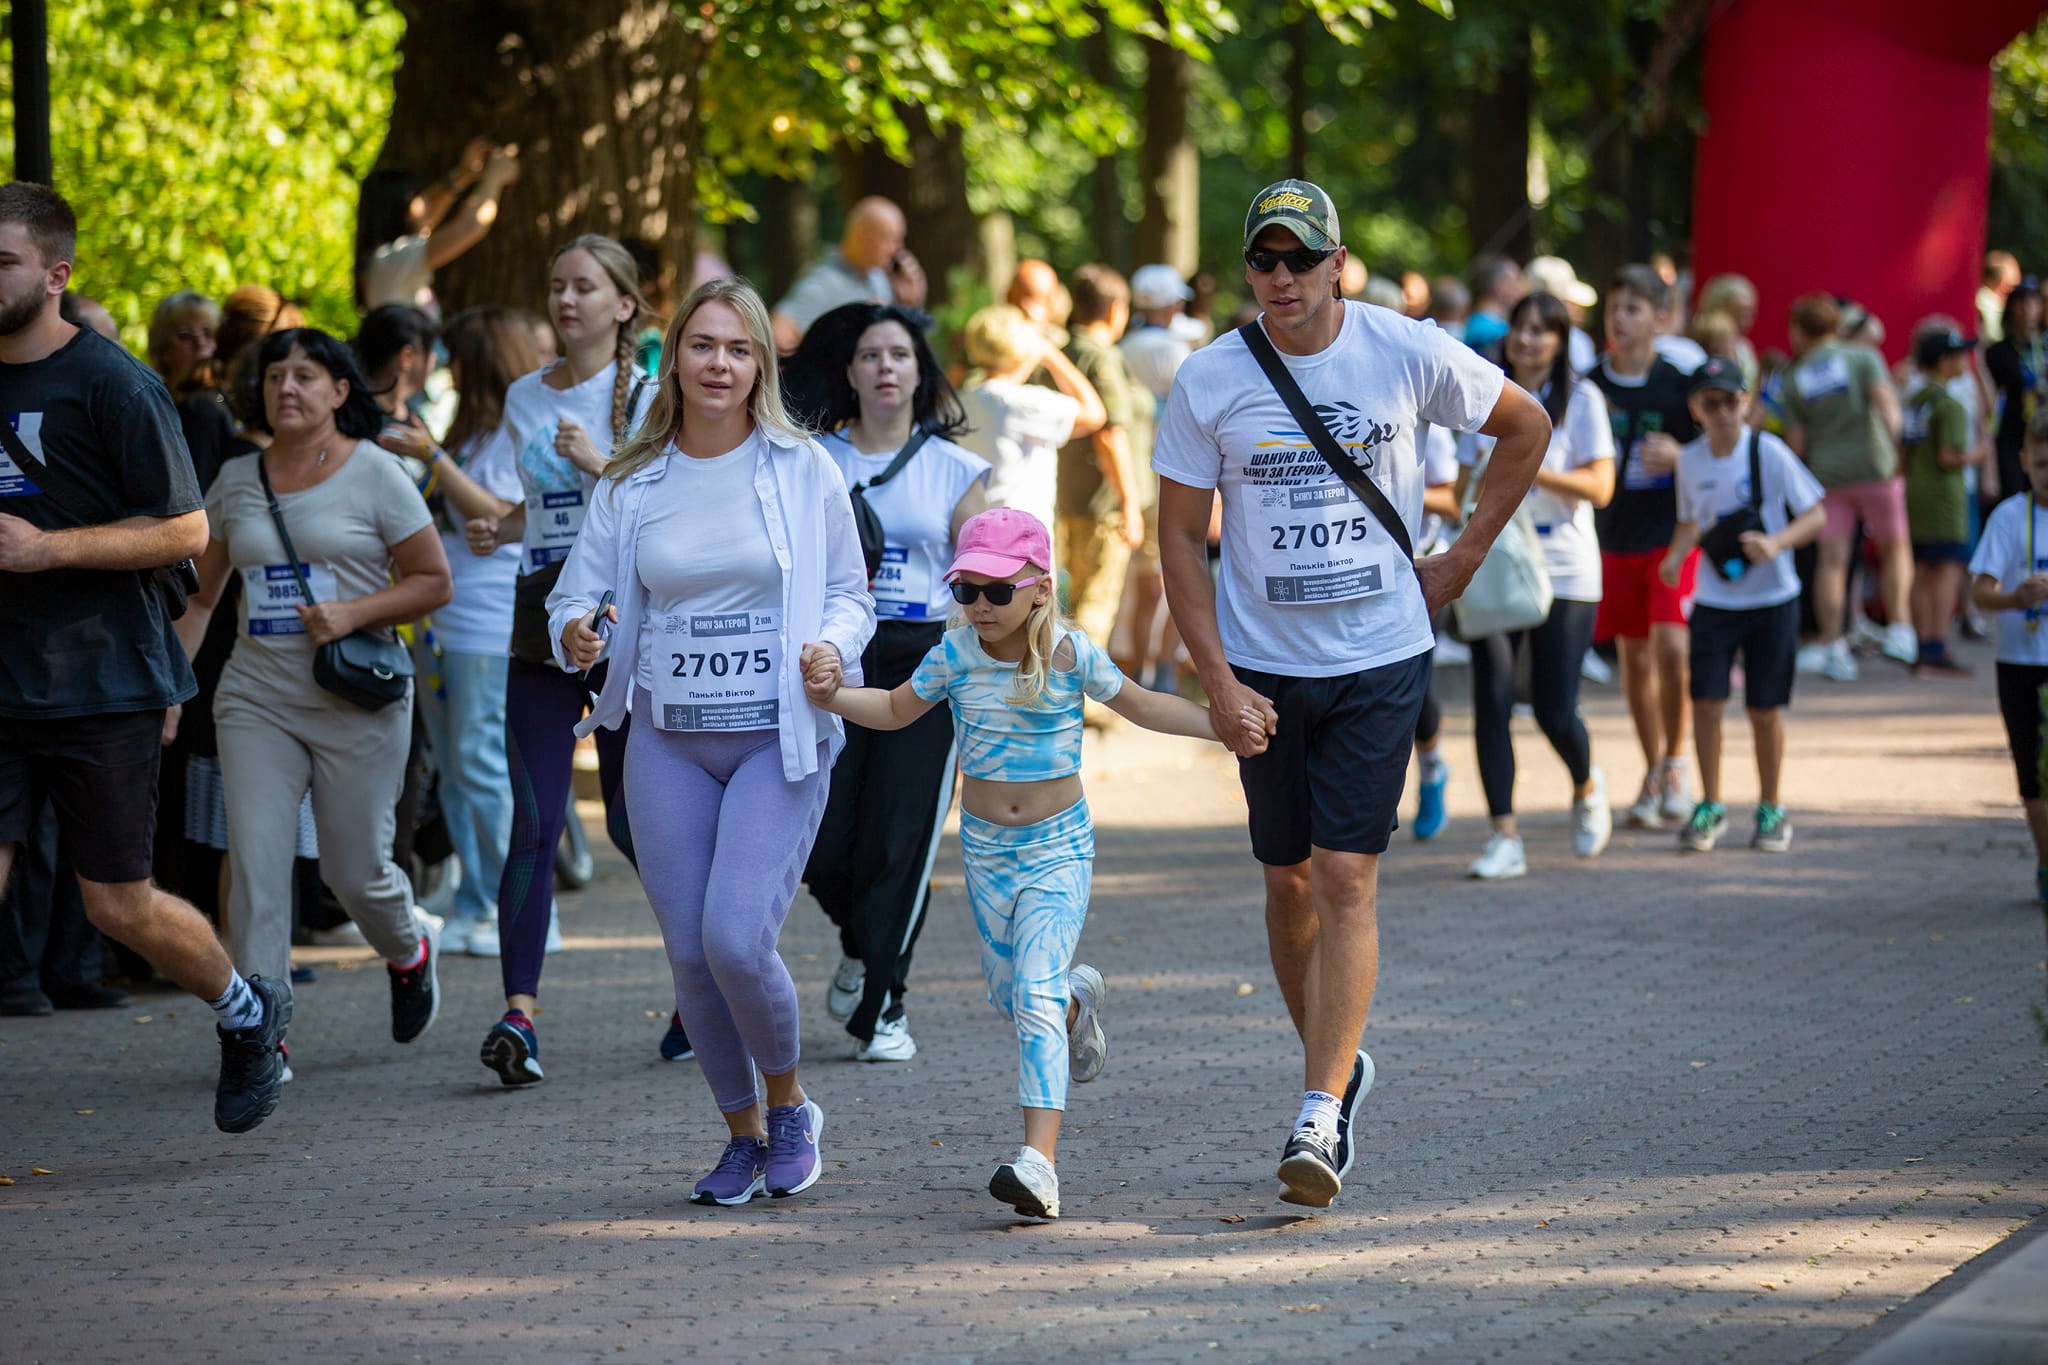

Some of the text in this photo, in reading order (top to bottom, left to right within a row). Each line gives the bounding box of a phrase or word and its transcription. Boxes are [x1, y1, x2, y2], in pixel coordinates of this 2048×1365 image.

[1250, 451, 1296, 466] ШАНУЮ
[1243, 463, 1327, 478] БІЖУ ЗА ГЕРОЇВ
[1293, 491, 1313, 502] БІЖУ
[1313, 490, 1324, 500] ЗА
[1324, 487, 1346, 499] ГЕРОЯ
[1270, 516, 1368, 550] 27075
[1290, 557, 1354, 571] Паньків Віктор
[694, 620, 713, 630] БІЖУ
[713, 619, 724, 629] ЗА
[724, 618, 747, 629] ГЕРОЯ
[754, 616, 760, 626] 2
[671, 648, 771, 678] 27075
[689, 689, 755, 699] Паньків Віктор
